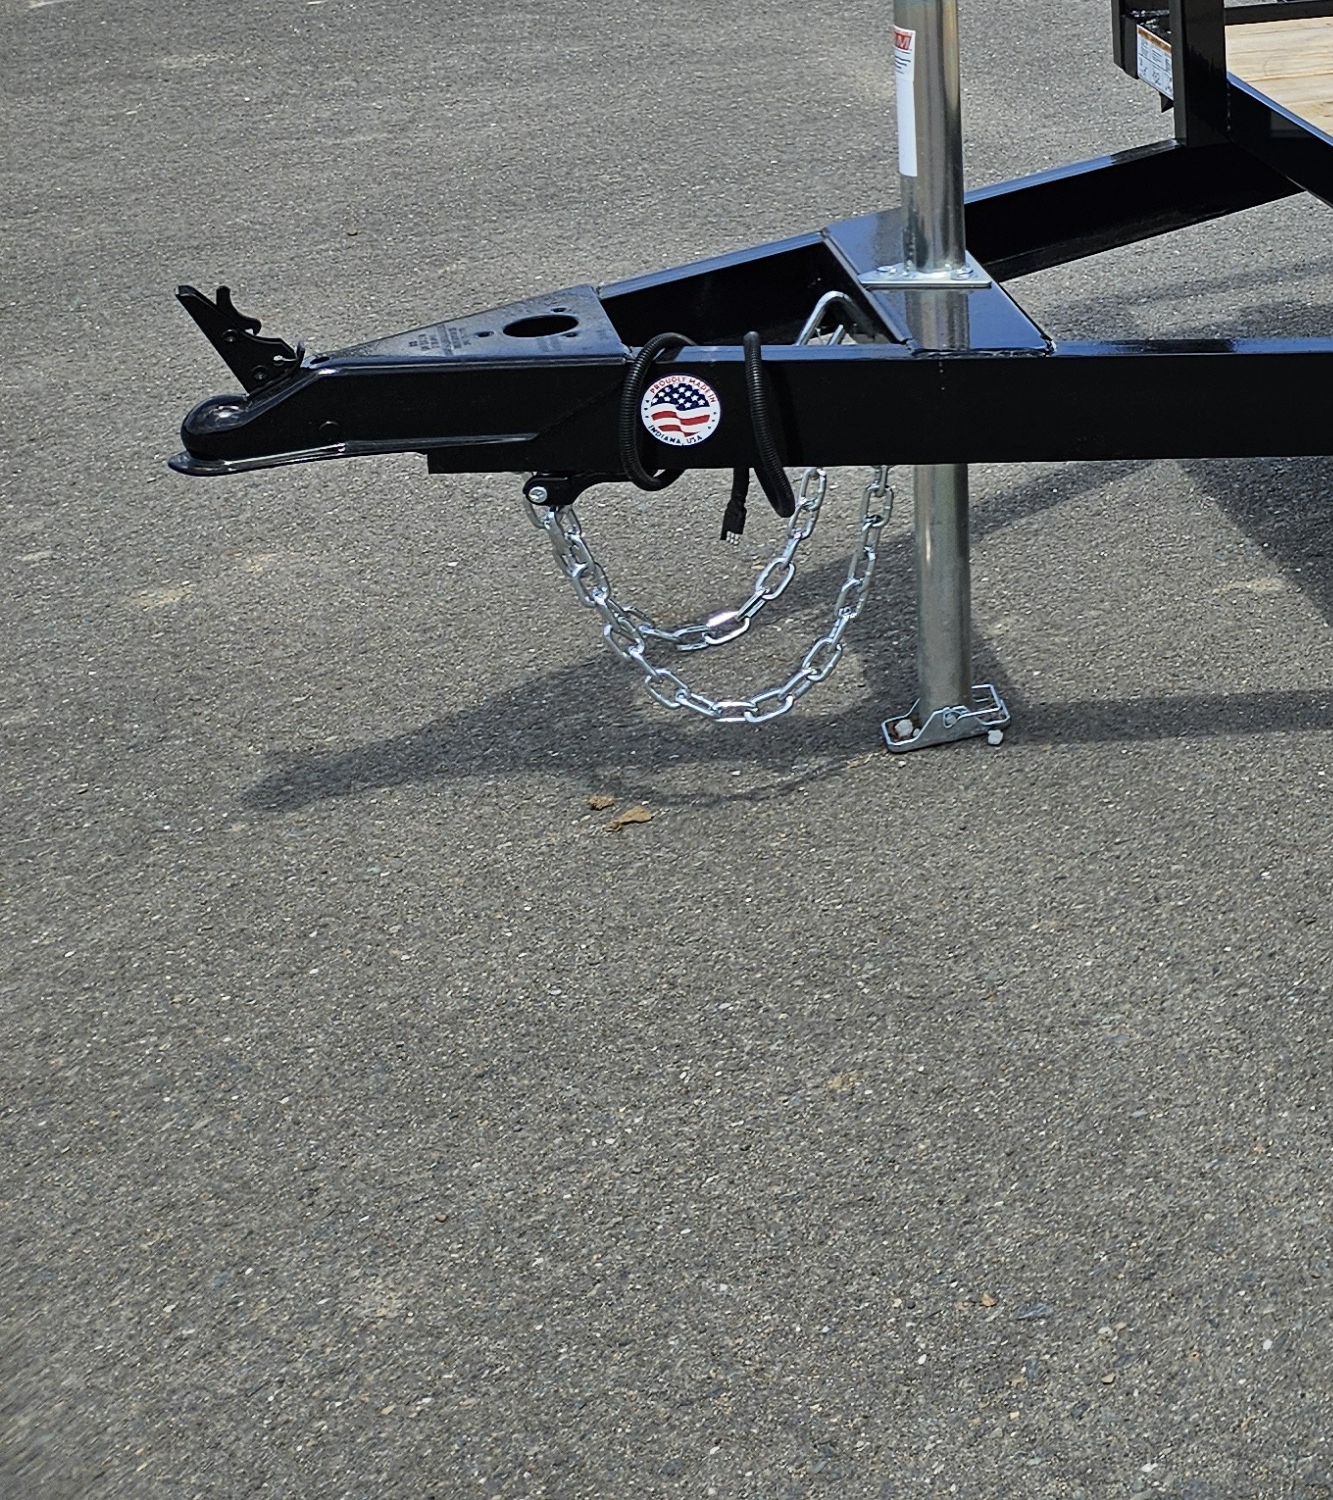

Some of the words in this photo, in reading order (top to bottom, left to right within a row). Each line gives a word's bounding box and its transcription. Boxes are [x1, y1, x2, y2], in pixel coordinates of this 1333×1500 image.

[650, 376, 686, 394] PROUDLY
[688, 378, 710, 393] MADE
[707, 393, 717, 404] IN
[686, 435, 703, 444] USA
